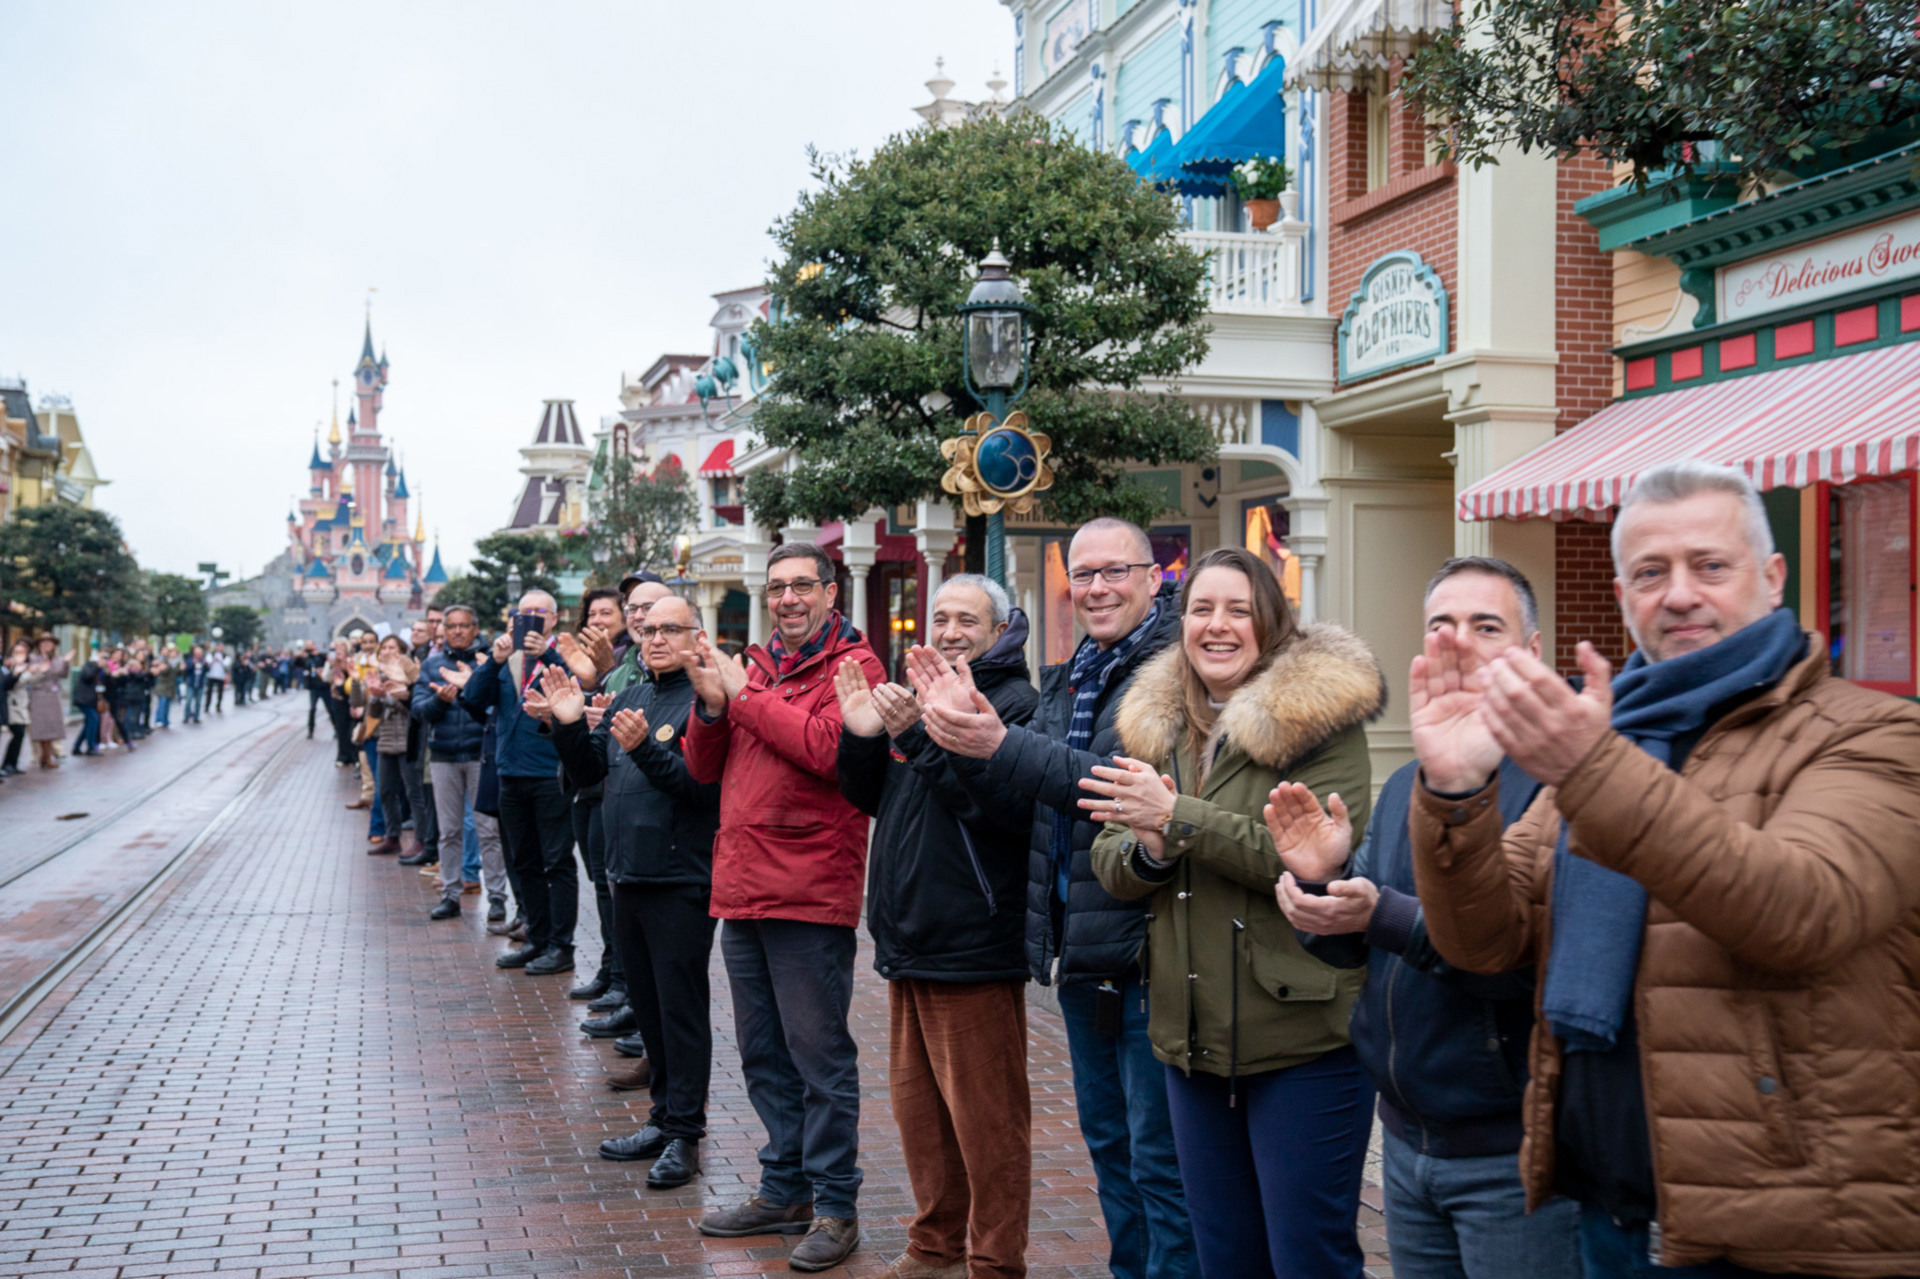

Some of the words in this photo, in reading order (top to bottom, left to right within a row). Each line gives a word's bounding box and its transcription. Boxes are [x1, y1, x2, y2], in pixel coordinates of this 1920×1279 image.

[1372, 267, 1414, 305] DISNEY
[1764, 257, 1863, 300] Delicious
[1356, 299, 1432, 360] CLOTHIERS
